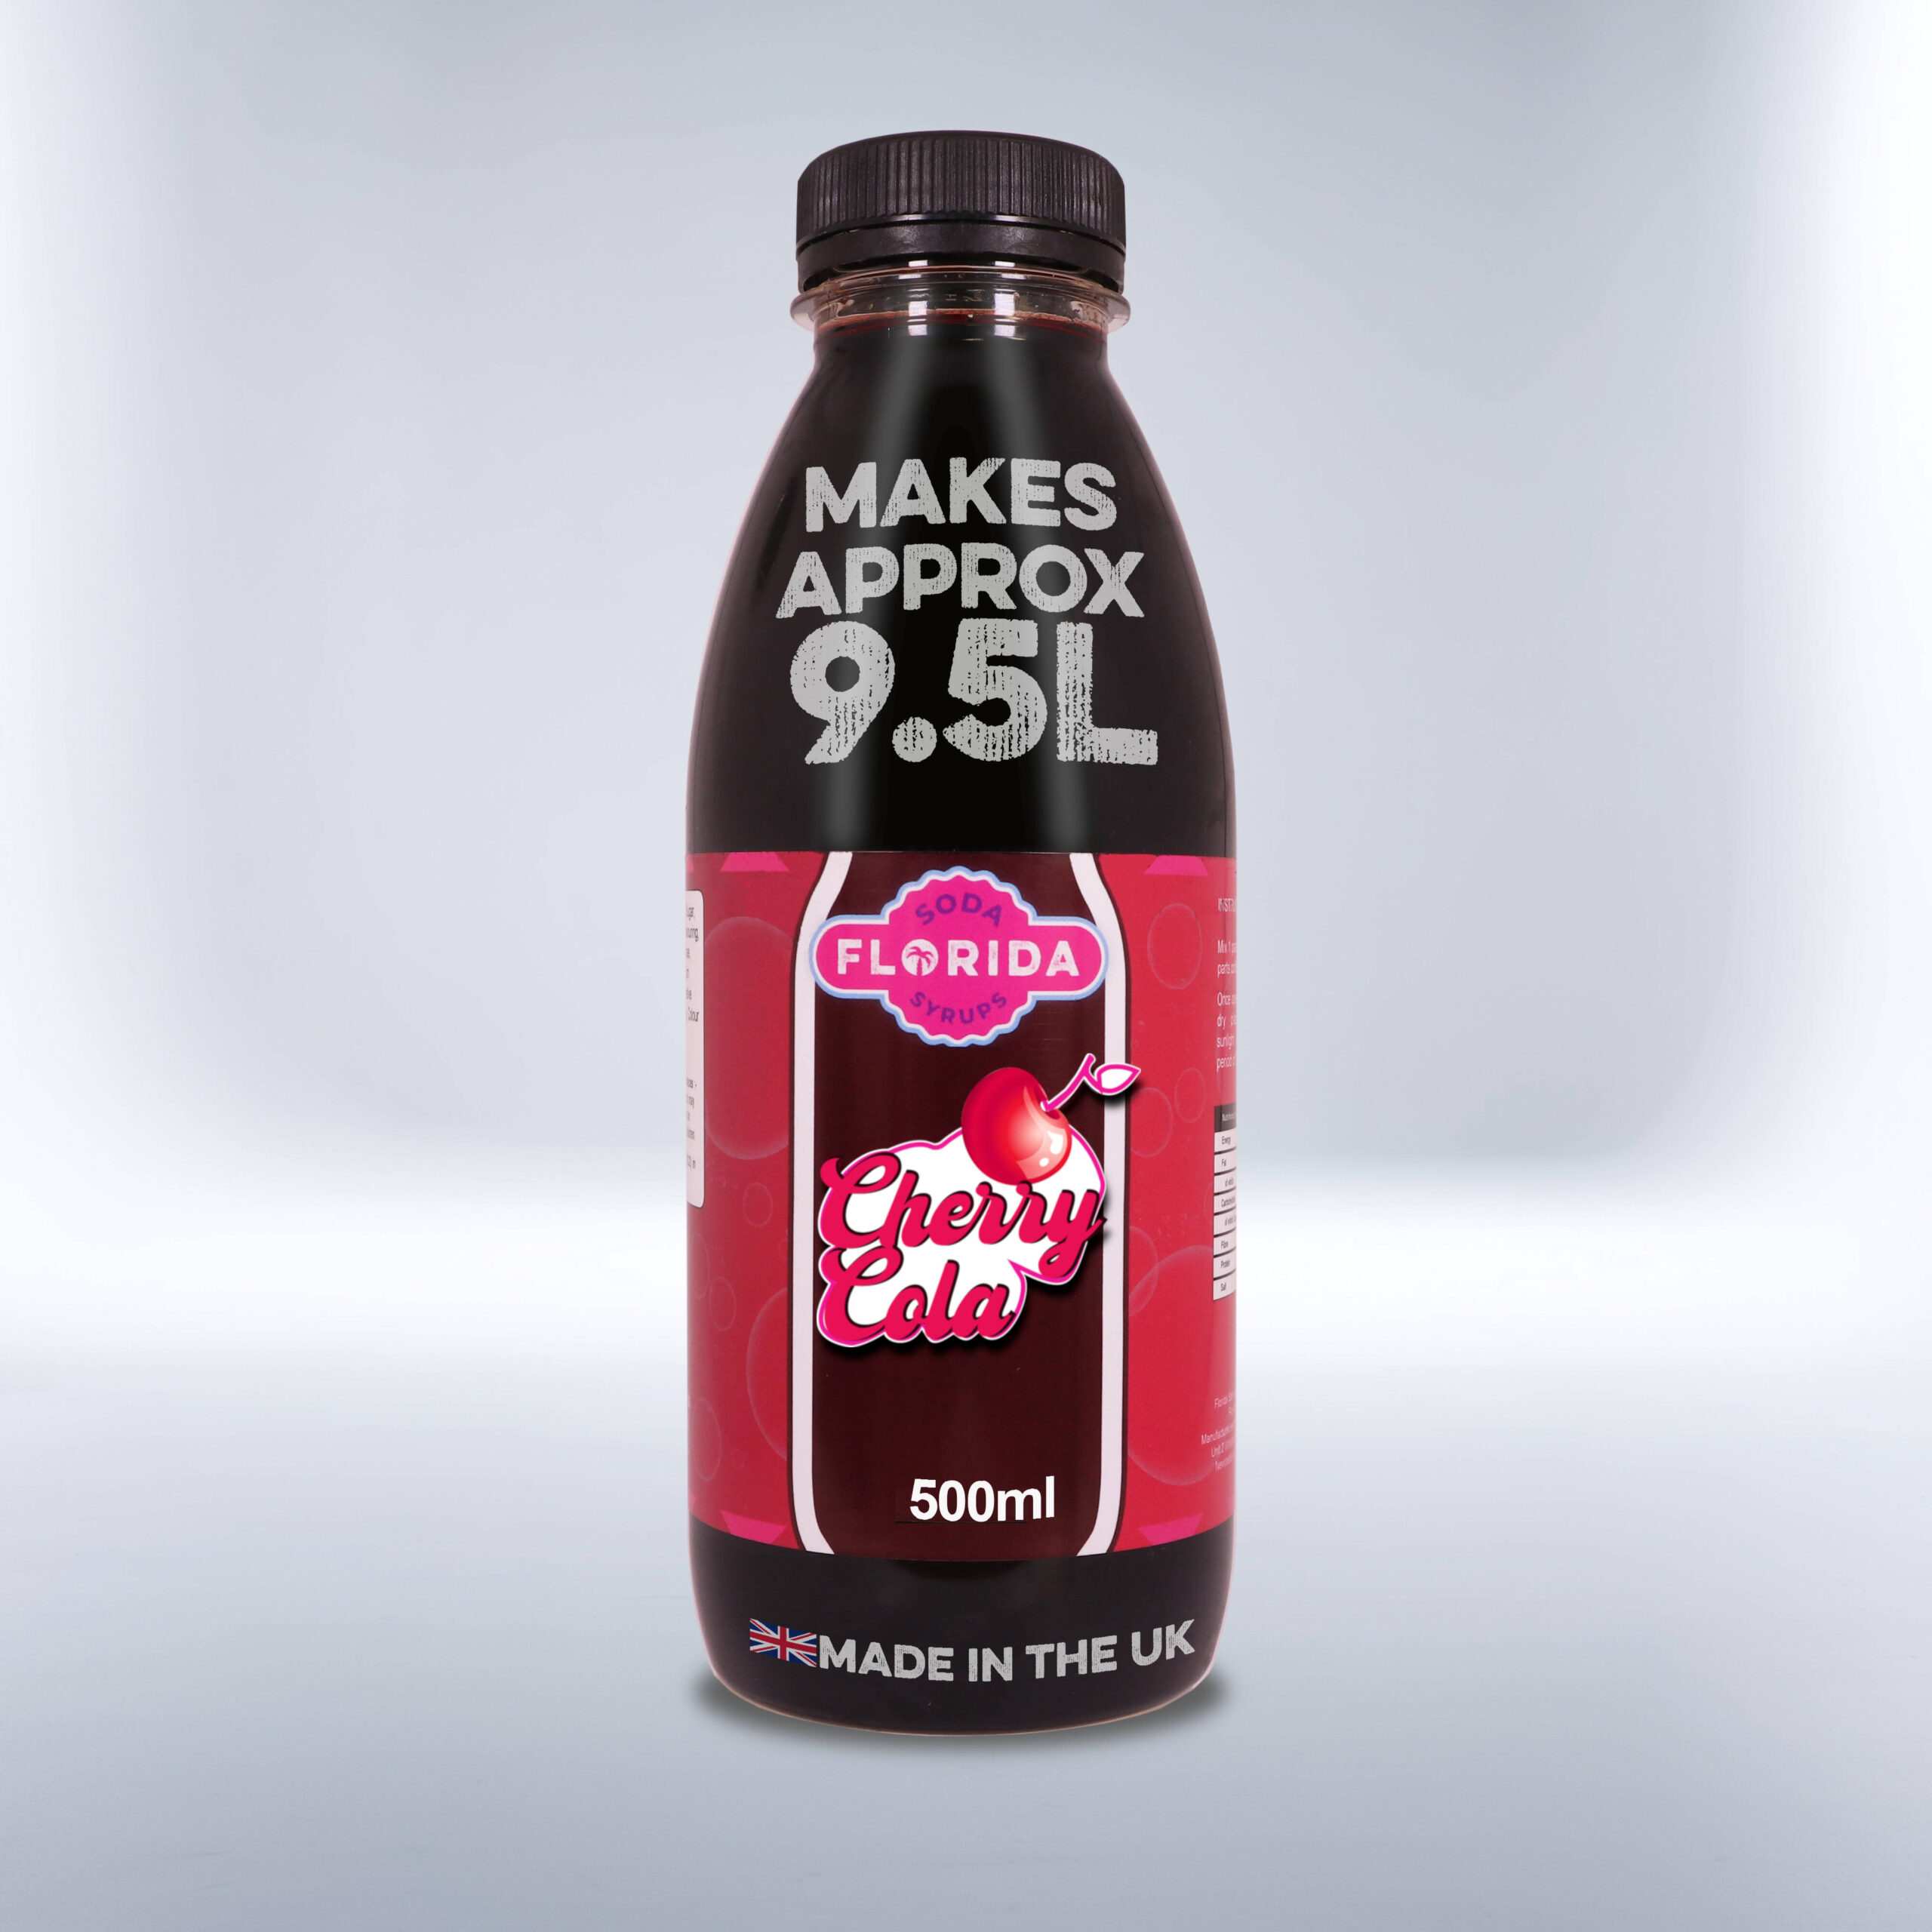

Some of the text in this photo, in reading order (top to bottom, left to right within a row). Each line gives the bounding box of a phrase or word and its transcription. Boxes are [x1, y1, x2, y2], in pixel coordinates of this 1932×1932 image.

[806, 457, 1116, 532] MAKES
[776, 543, 1144, 618] APPROX
[790, 619, 1158, 764] 9.5L
[915, 893, 1002, 926] SODA
[838, 939, 1079, 976] FLORIDA
[910, 992, 1007, 1024] SYRUPS
[1217, 991, 1232, 1006] Once
[1217, 1012, 1226, 1030] dry
[820, 1152, 1107, 1278] Cherry
[820, 1244, 1017, 1342] Cola
[910, 1476, 1055, 1522] 500ml
[820, 1620, 1195, 1682] MADE IN THE UK
